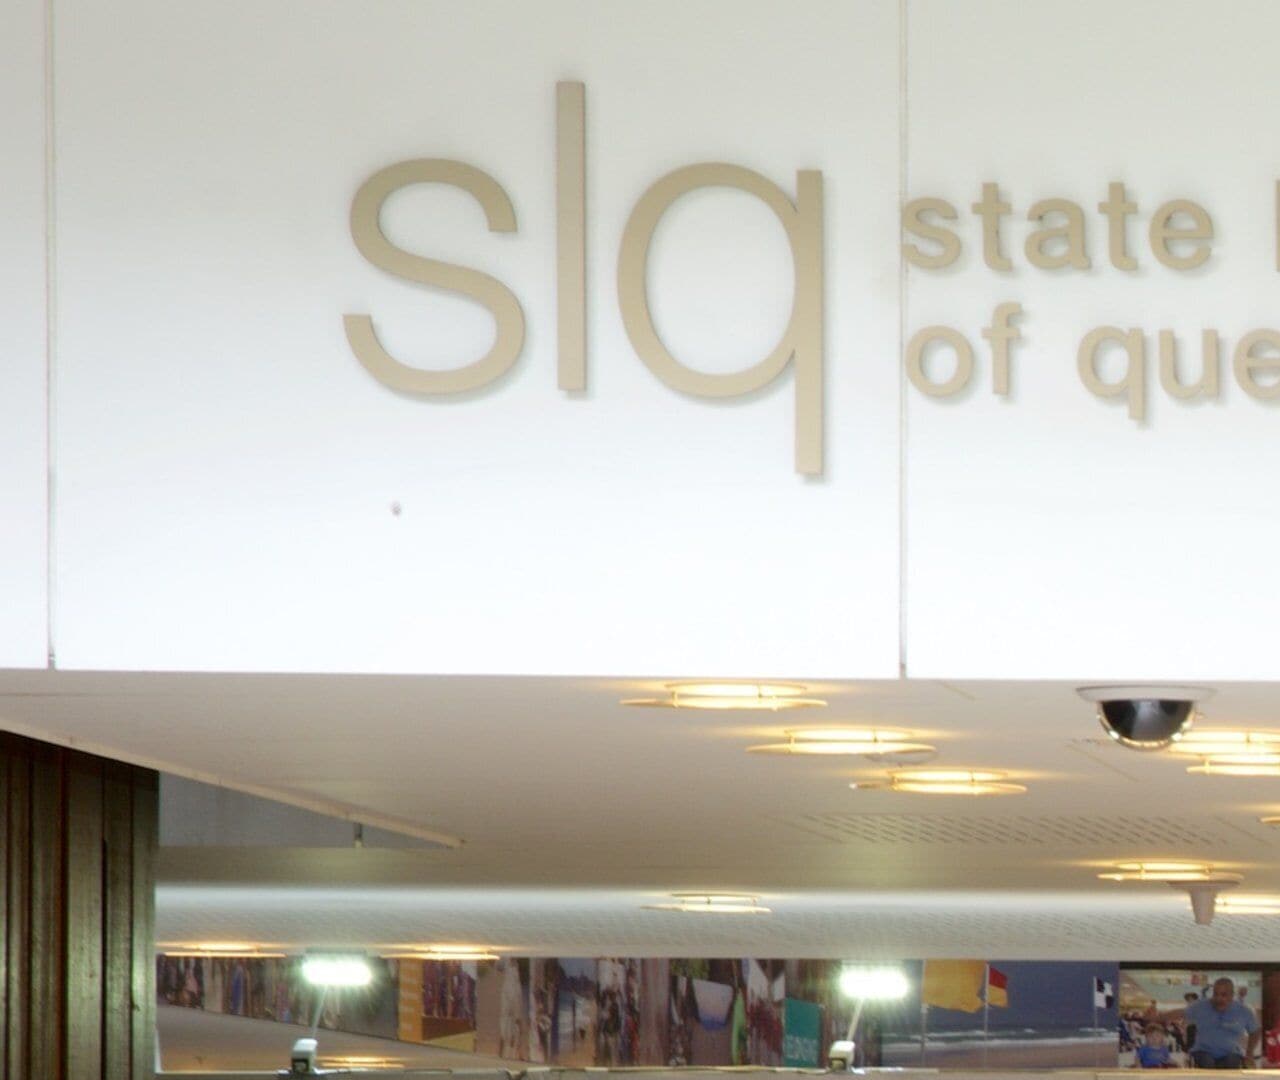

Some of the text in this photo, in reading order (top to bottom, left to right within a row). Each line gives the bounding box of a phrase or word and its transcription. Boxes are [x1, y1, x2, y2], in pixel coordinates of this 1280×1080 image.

[902, 181, 1214, 275] state
[343, 80, 824, 475] slq
[904, 303, 1022, 400] of
